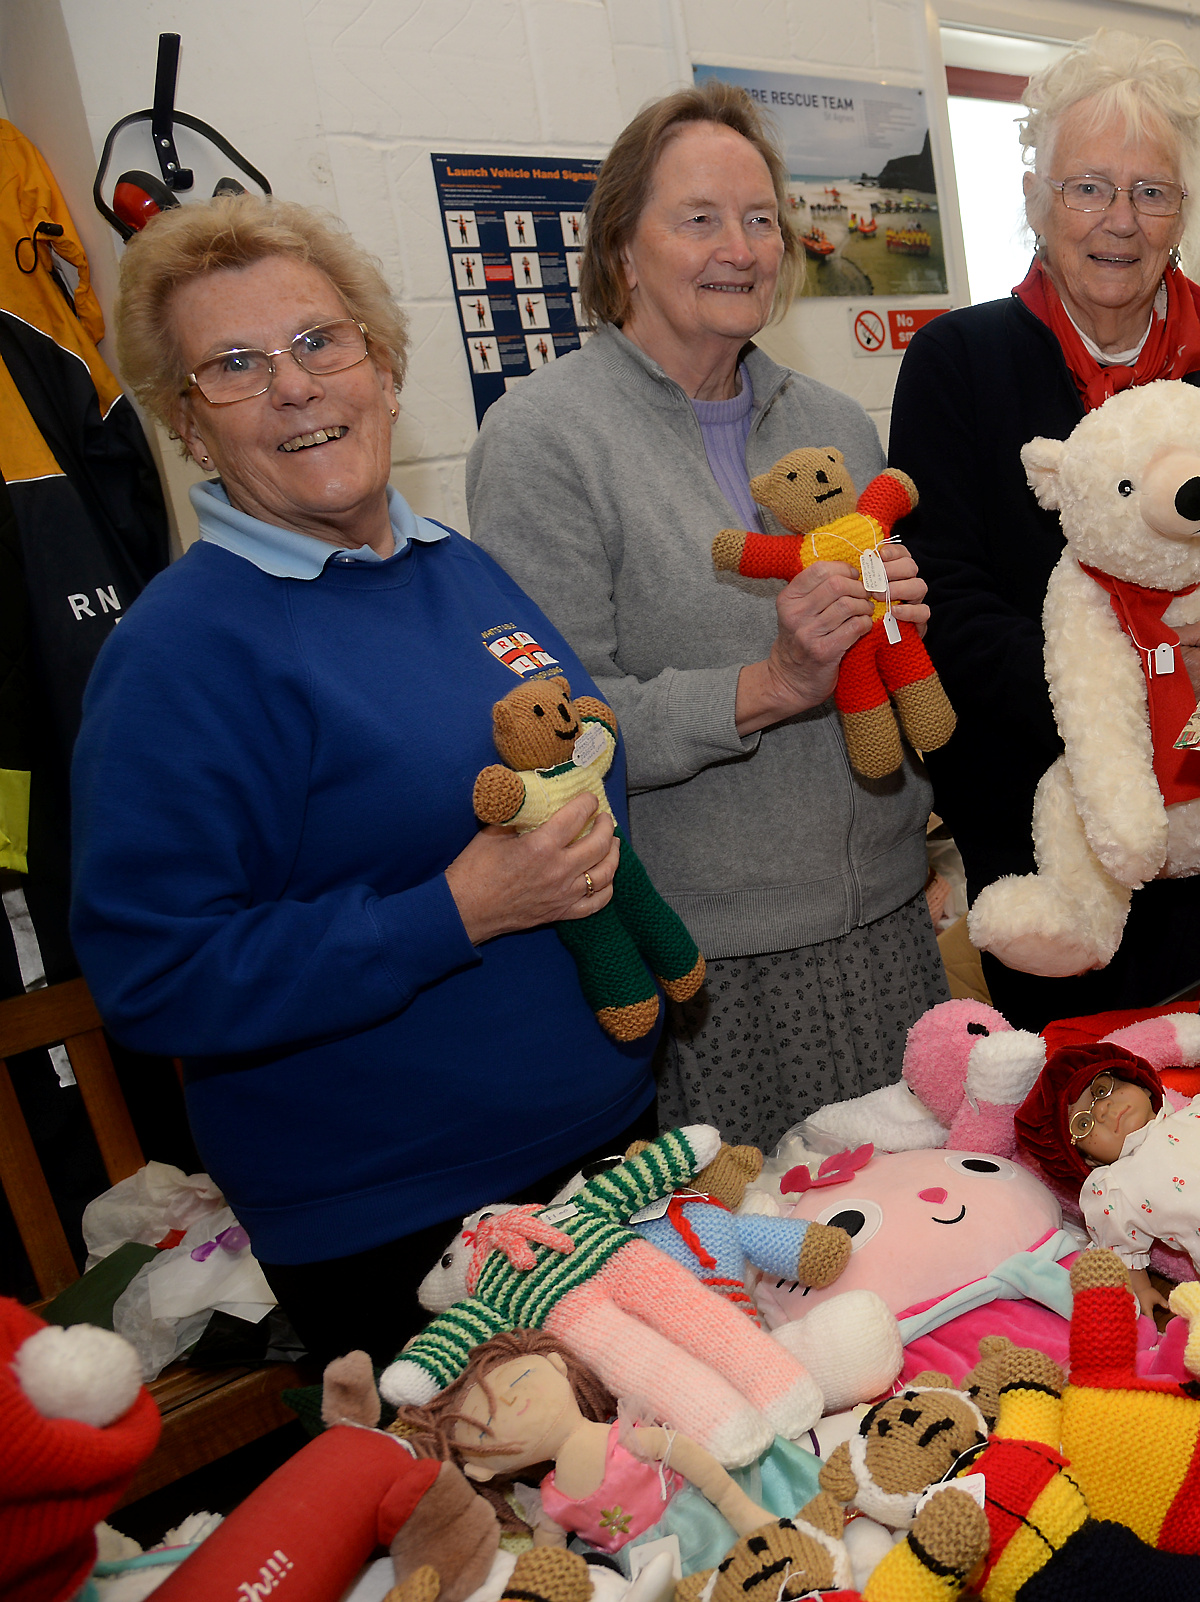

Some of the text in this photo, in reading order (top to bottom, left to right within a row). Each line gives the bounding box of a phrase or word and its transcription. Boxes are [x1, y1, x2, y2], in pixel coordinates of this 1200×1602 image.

[771, 90, 819, 109] RESCUE
[822, 96, 854, 111] TEAM
[446, 166, 598, 182] Launch Vehicle Hand Signals
[896, 314, 914, 327] No
